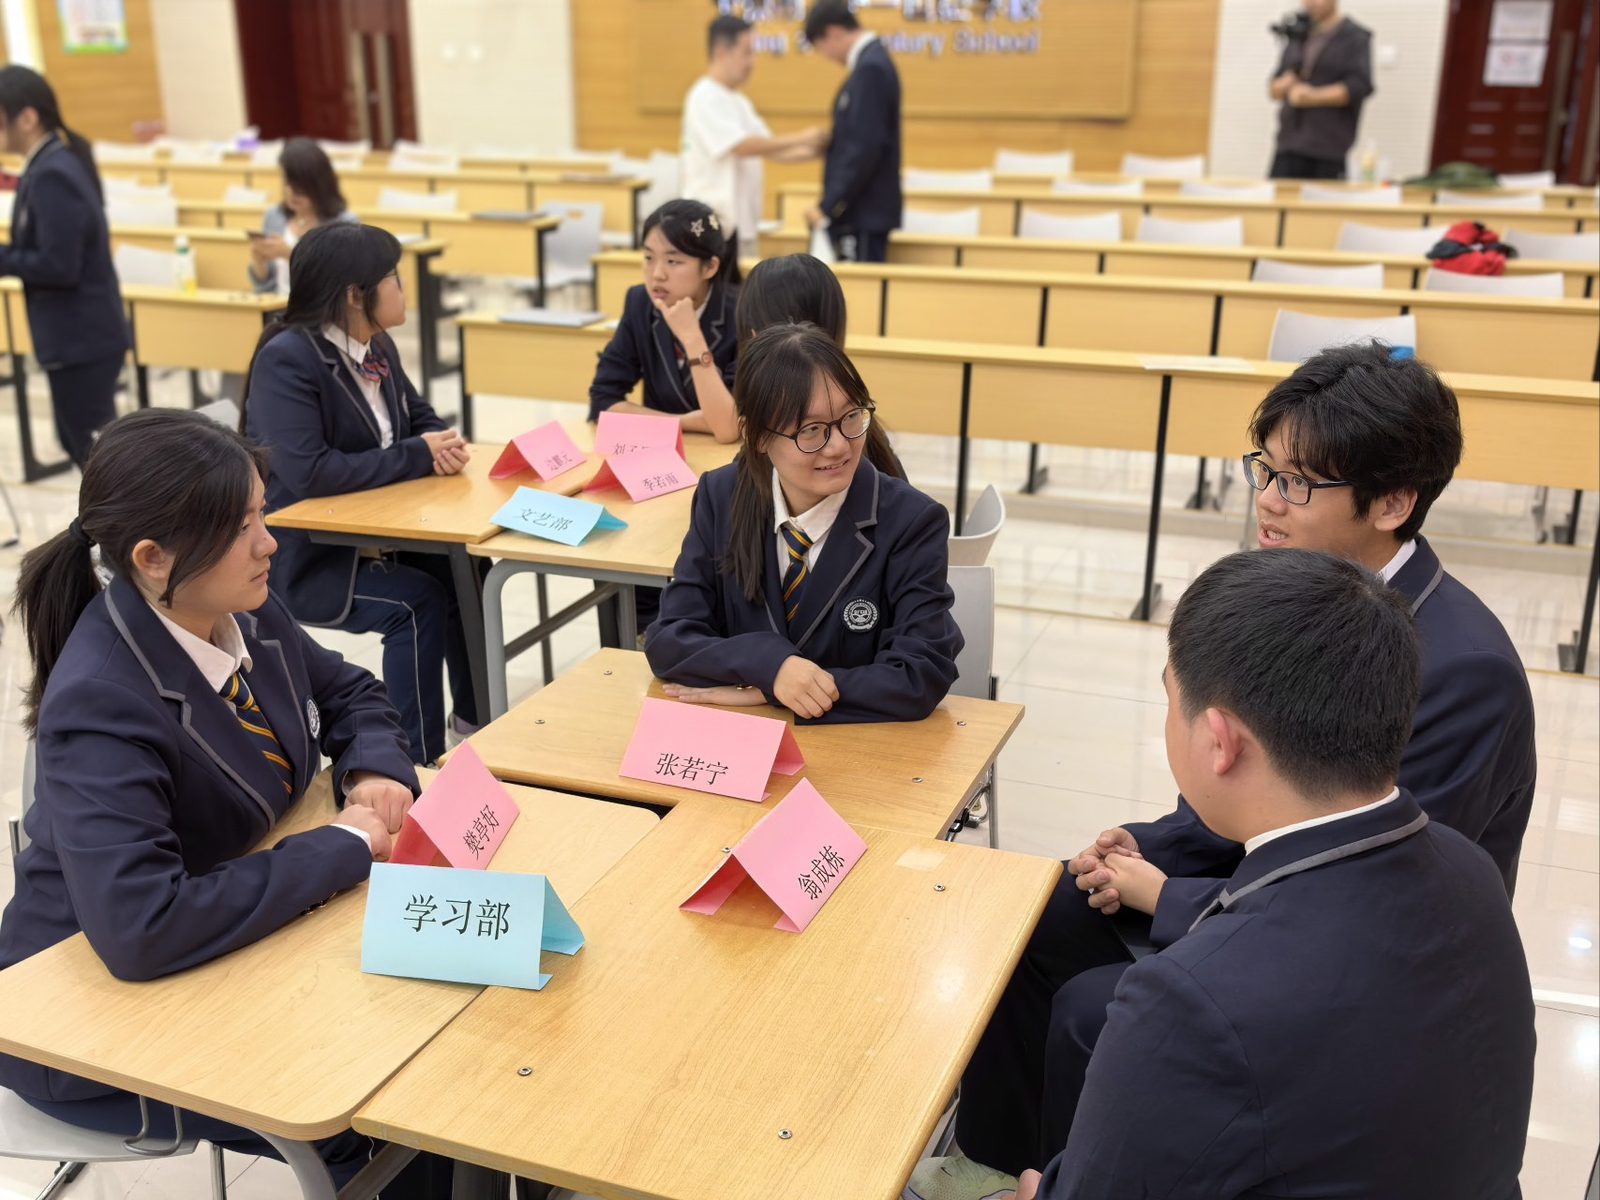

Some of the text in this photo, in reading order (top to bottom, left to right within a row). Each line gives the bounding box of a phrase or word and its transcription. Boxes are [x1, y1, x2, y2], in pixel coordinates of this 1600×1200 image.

[953, 31, 1039, 54] School
[516, 508, 573, 531] 文艺部
[655, 753, 729, 785] 张若宁
[463, 804, 499, 861] 樊亭好
[798, 846, 845, 900] 翁成栋
[403, 894, 511, 940] 学习部
